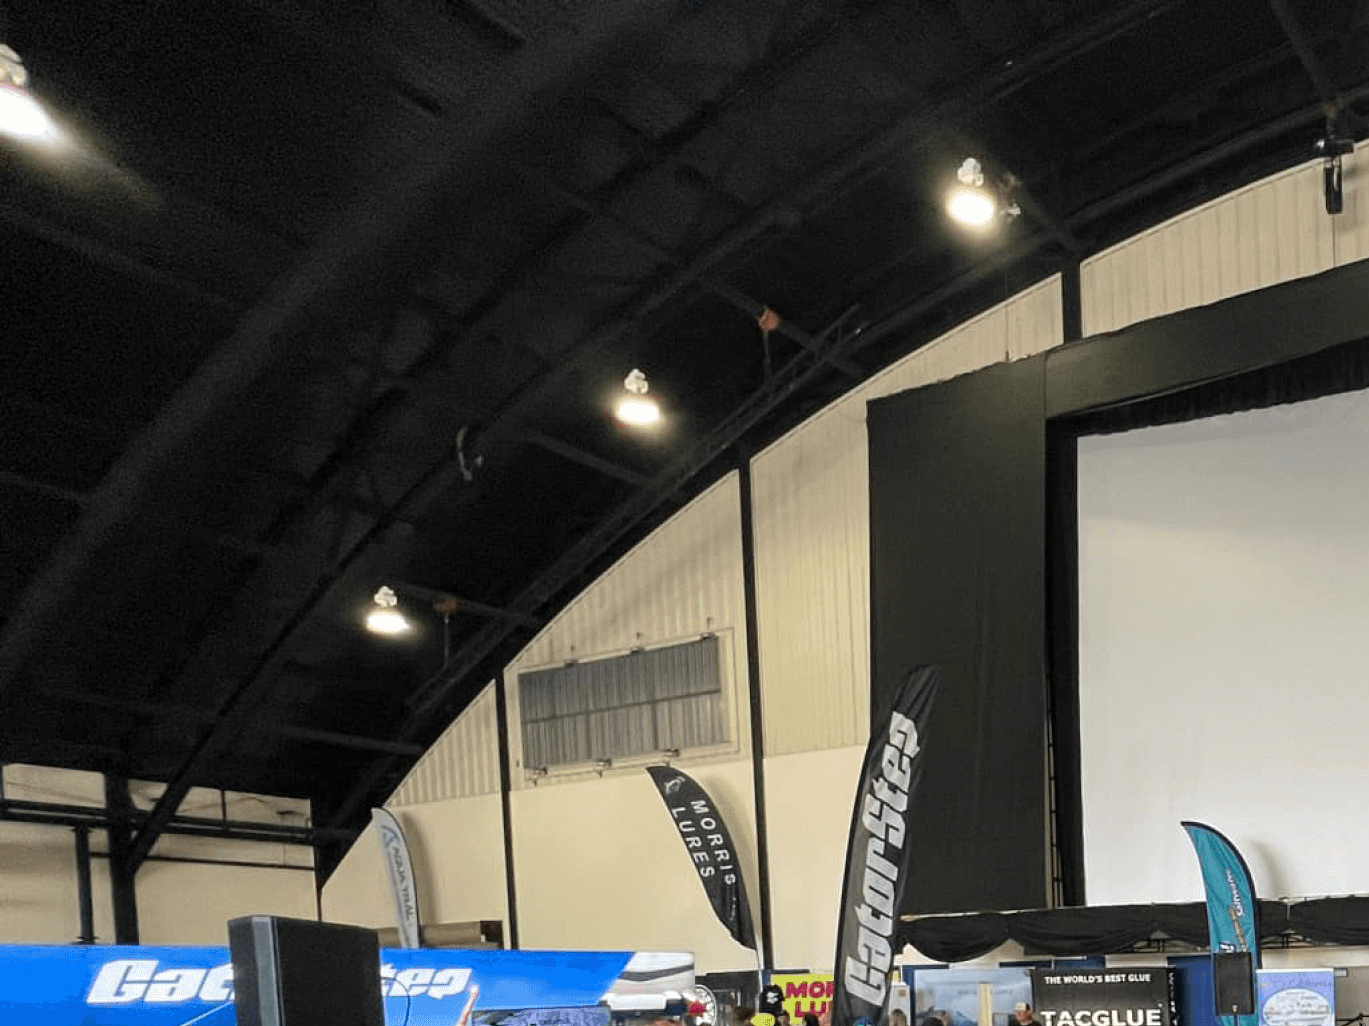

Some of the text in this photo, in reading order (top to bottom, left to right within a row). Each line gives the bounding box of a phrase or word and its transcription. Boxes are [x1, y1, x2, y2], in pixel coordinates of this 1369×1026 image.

[671, 806, 716, 878] LURES
[690, 799, 736, 886] MORRIS
[844, 710, 920, 1007] GatorStep
[1044, 973, 1151, 985] THE WORLD'S BEST GLUE
